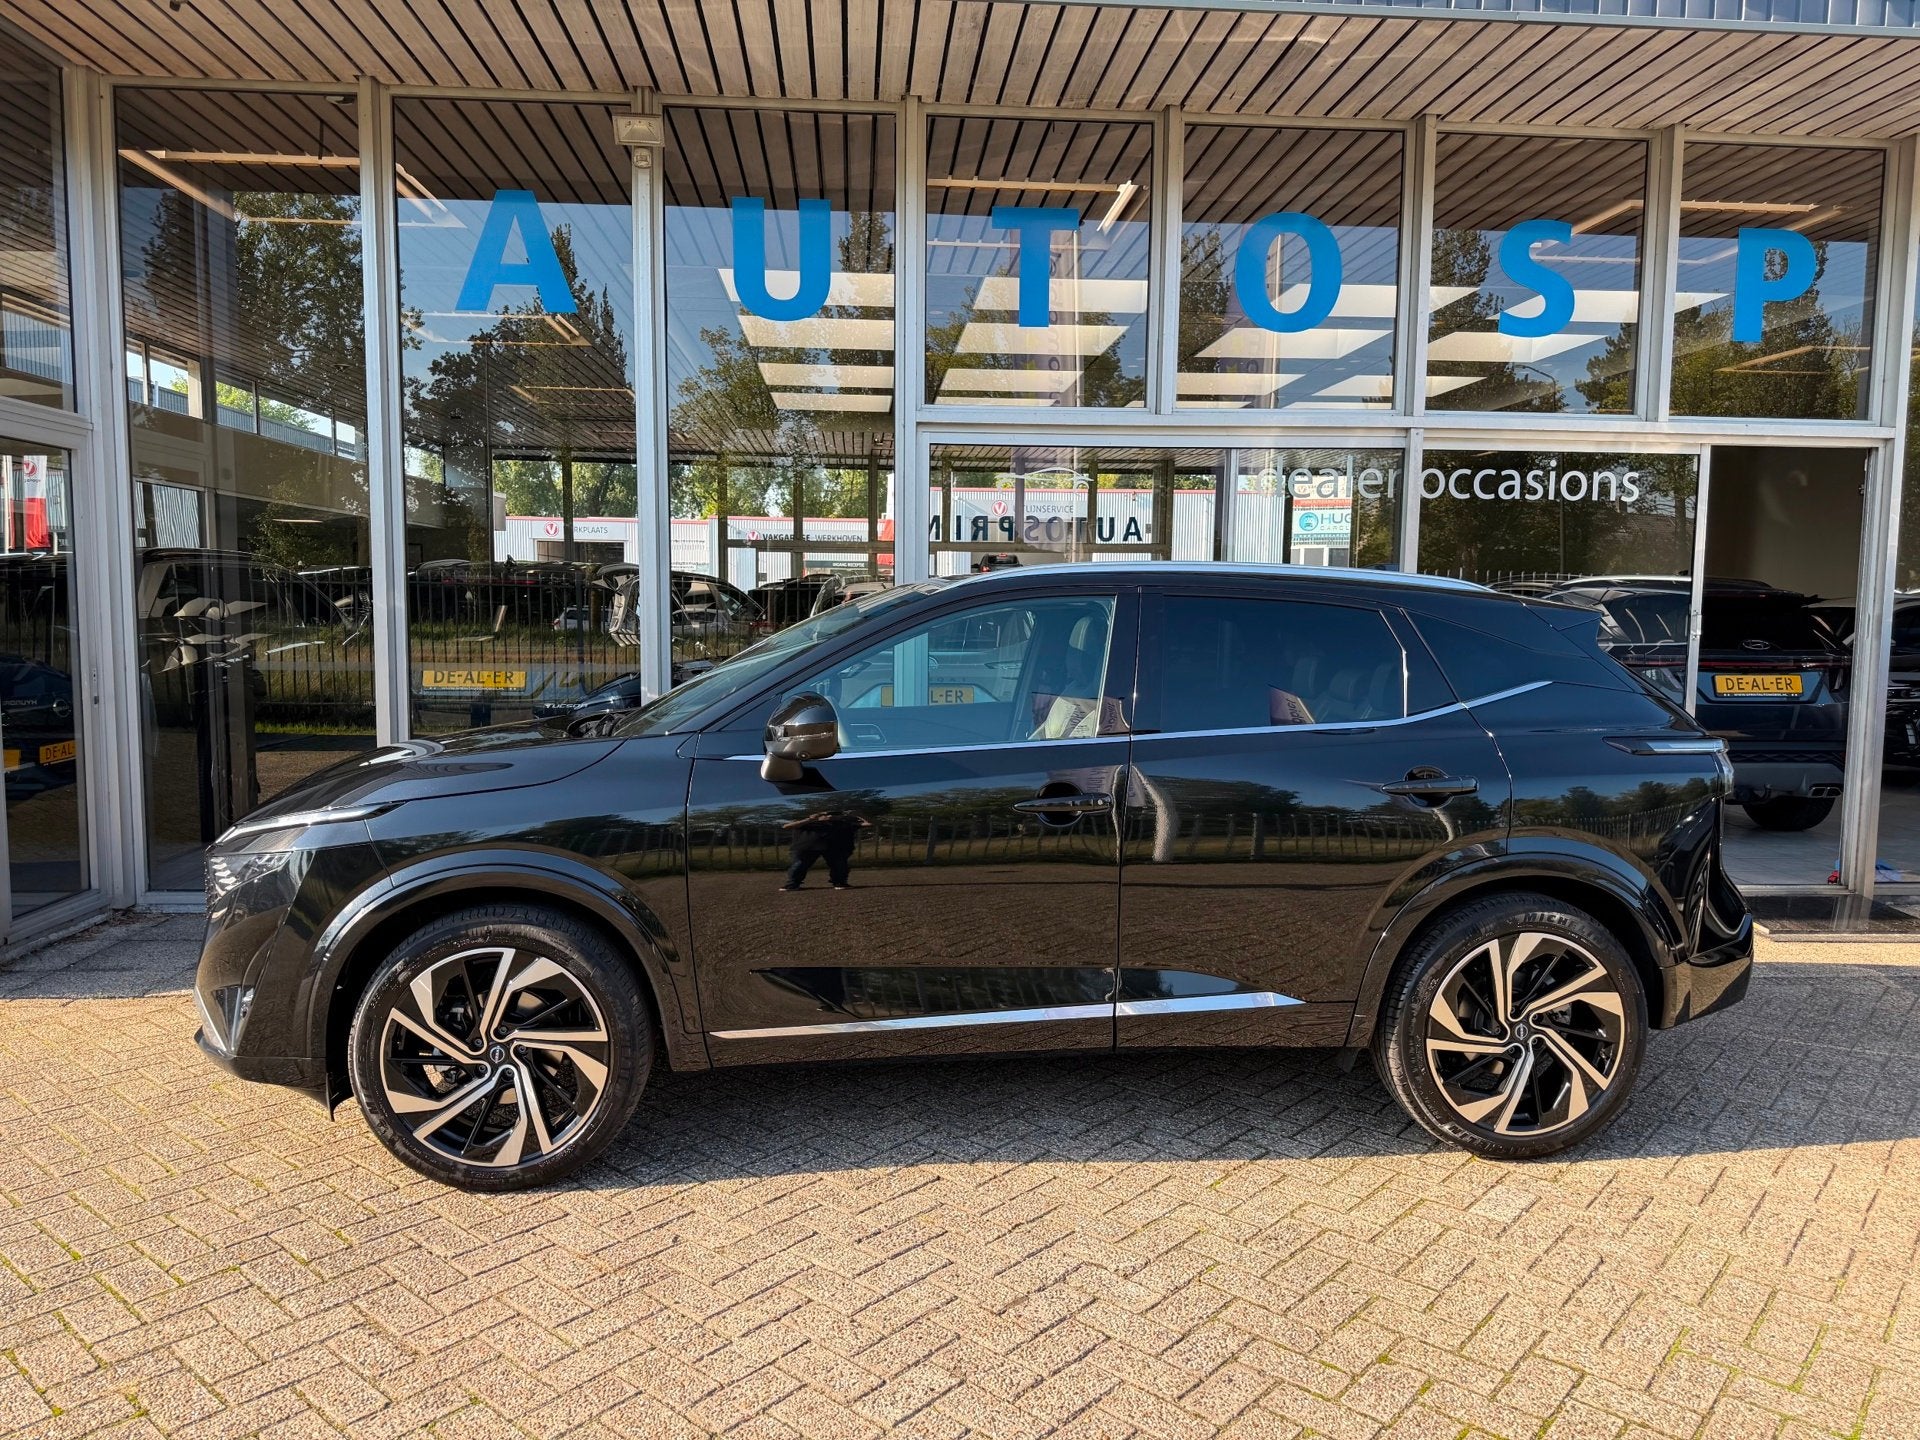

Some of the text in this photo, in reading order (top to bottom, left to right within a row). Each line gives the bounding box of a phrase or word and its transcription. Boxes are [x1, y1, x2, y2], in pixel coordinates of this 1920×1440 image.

[1418, 460, 1640, 501] occasions
[573, 526, 608, 534] RKPLAATS
[763, 533, 810, 541] VAKGARE
[433, 671, 514, 684] DE-AL-ER
[1725, 677, 1794, 691] DE-AL-ER
[930, 689, 964, 703] L-ER
